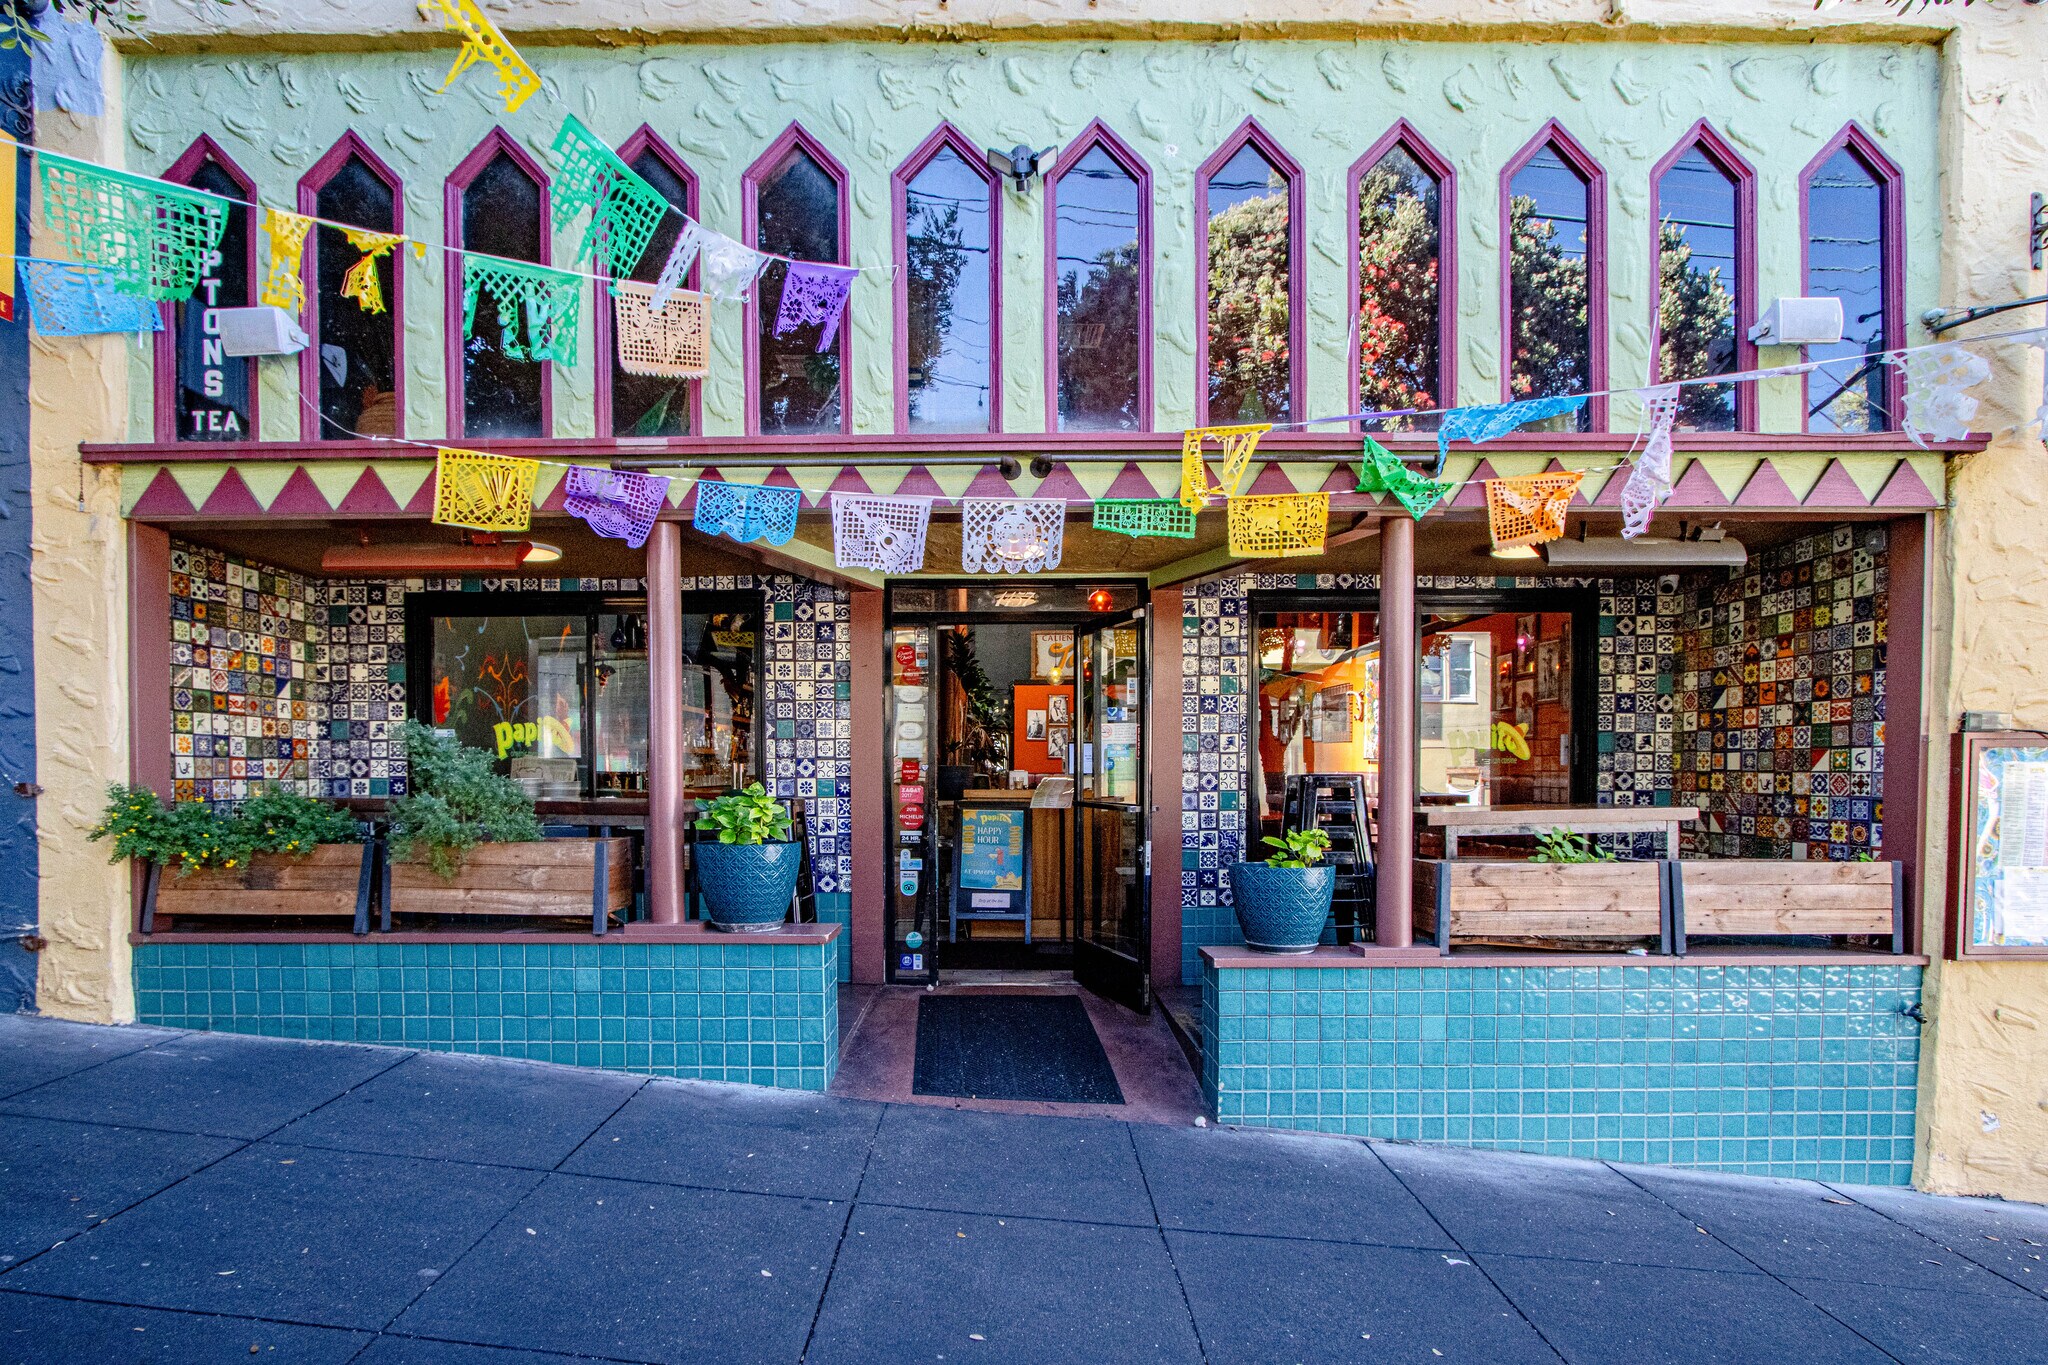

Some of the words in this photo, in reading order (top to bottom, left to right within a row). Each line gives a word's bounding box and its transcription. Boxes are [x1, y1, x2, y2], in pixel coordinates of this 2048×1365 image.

[191, 410, 241, 432] TEA
[1041, 634, 1073, 642] CALIEN
[977, 826, 1002, 835] HAPPY
[977, 835, 999, 844] HOUR
